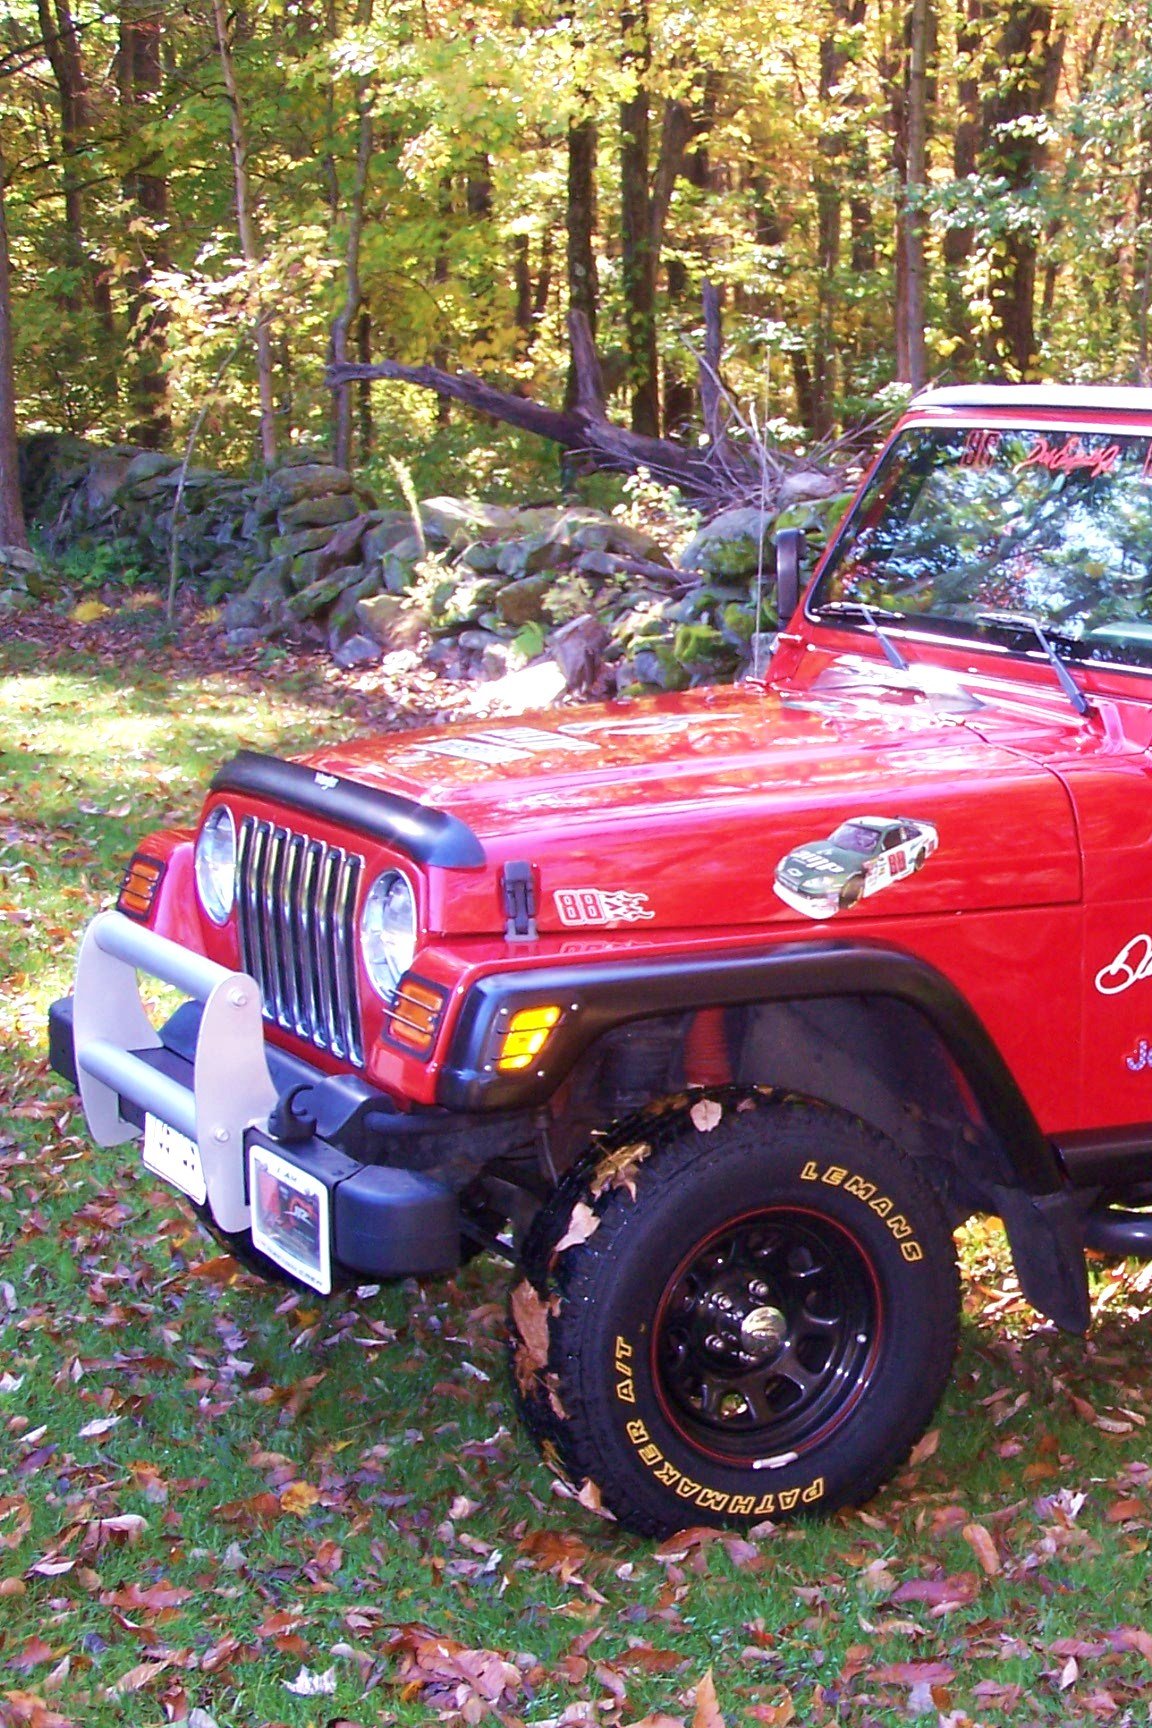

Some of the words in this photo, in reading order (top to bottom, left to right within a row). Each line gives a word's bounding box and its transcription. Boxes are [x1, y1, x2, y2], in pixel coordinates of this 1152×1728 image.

[554, 888, 607, 926] 88
[800, 1161, 923, 1263] LEMANS
[615, 1336, 636, 1404] A/T
[625, 1418, 826, 1515] PATHMAKER
